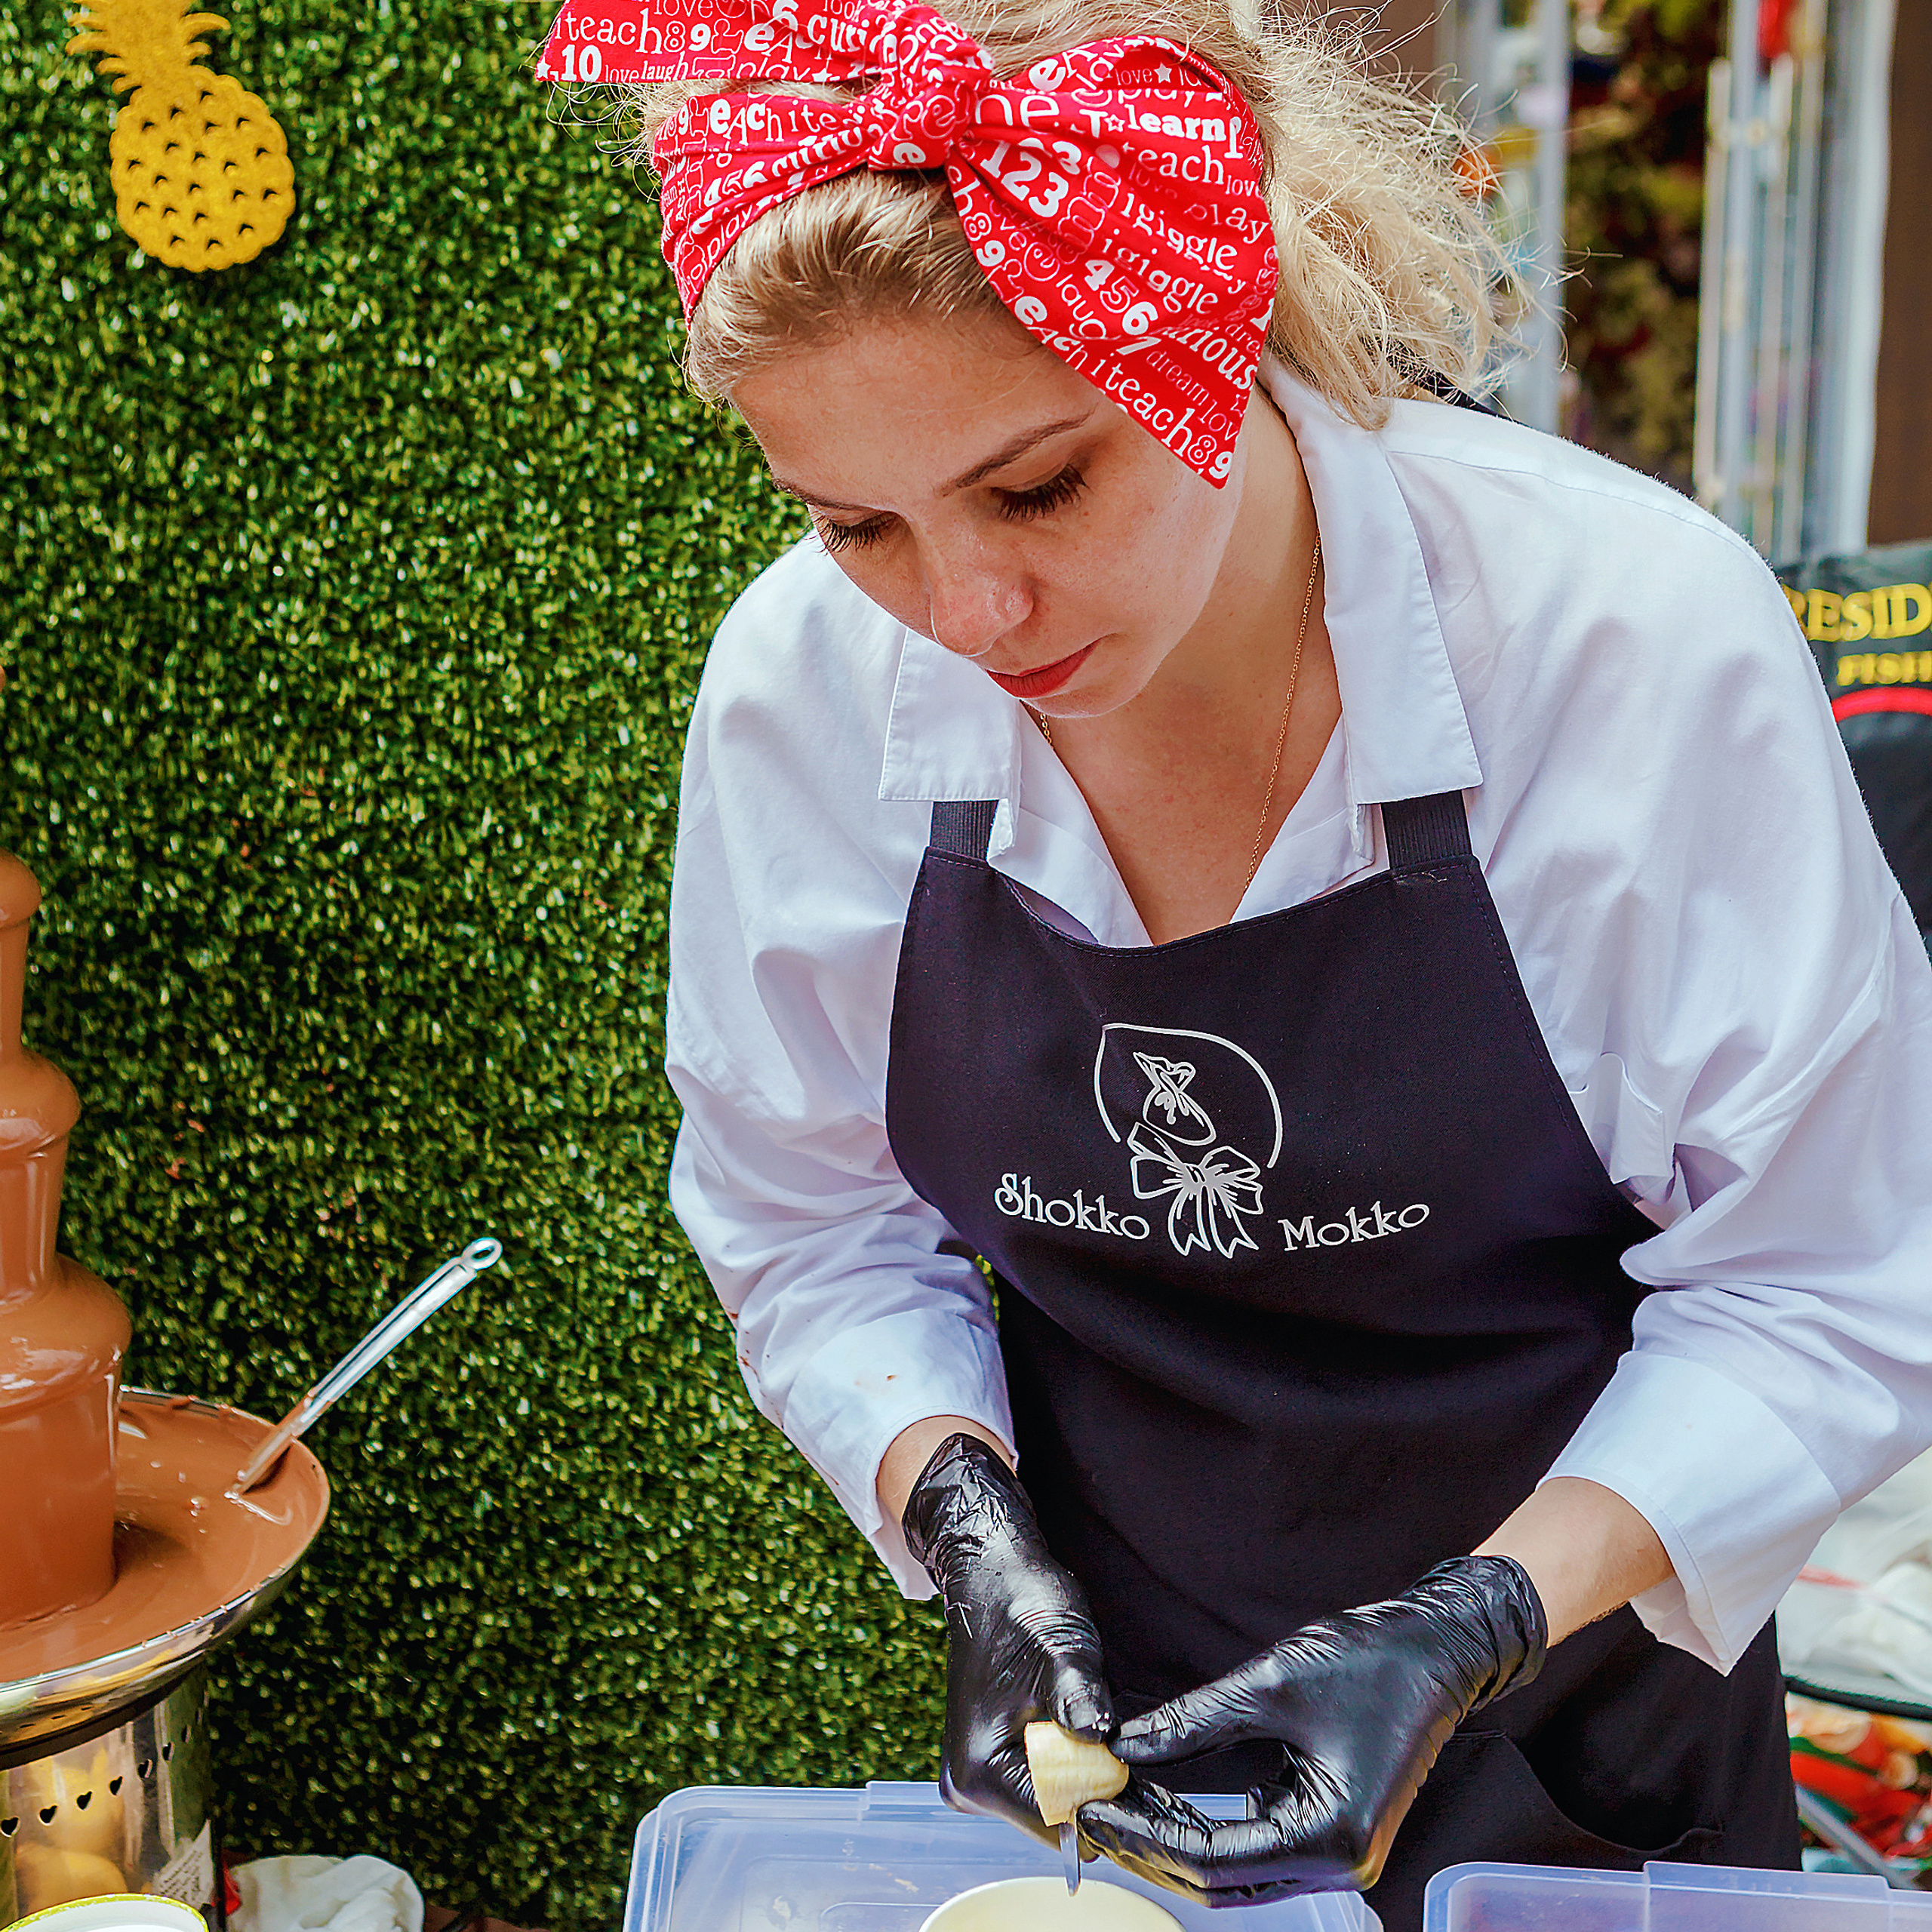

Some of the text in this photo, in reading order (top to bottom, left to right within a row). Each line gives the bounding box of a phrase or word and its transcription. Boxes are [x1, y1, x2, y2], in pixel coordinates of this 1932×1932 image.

[561, 44, 602, 82] 10
[641, 51, 689, 82] laugh
[1115, 67, 1153, 87] love
[1124, 104, 1226, 142] learn
[1146, 349, 1211, 407] dream
[1782, 583, 1932, 642] ESID
[994, 1173, 1430, 1251] Shokko Mokko
